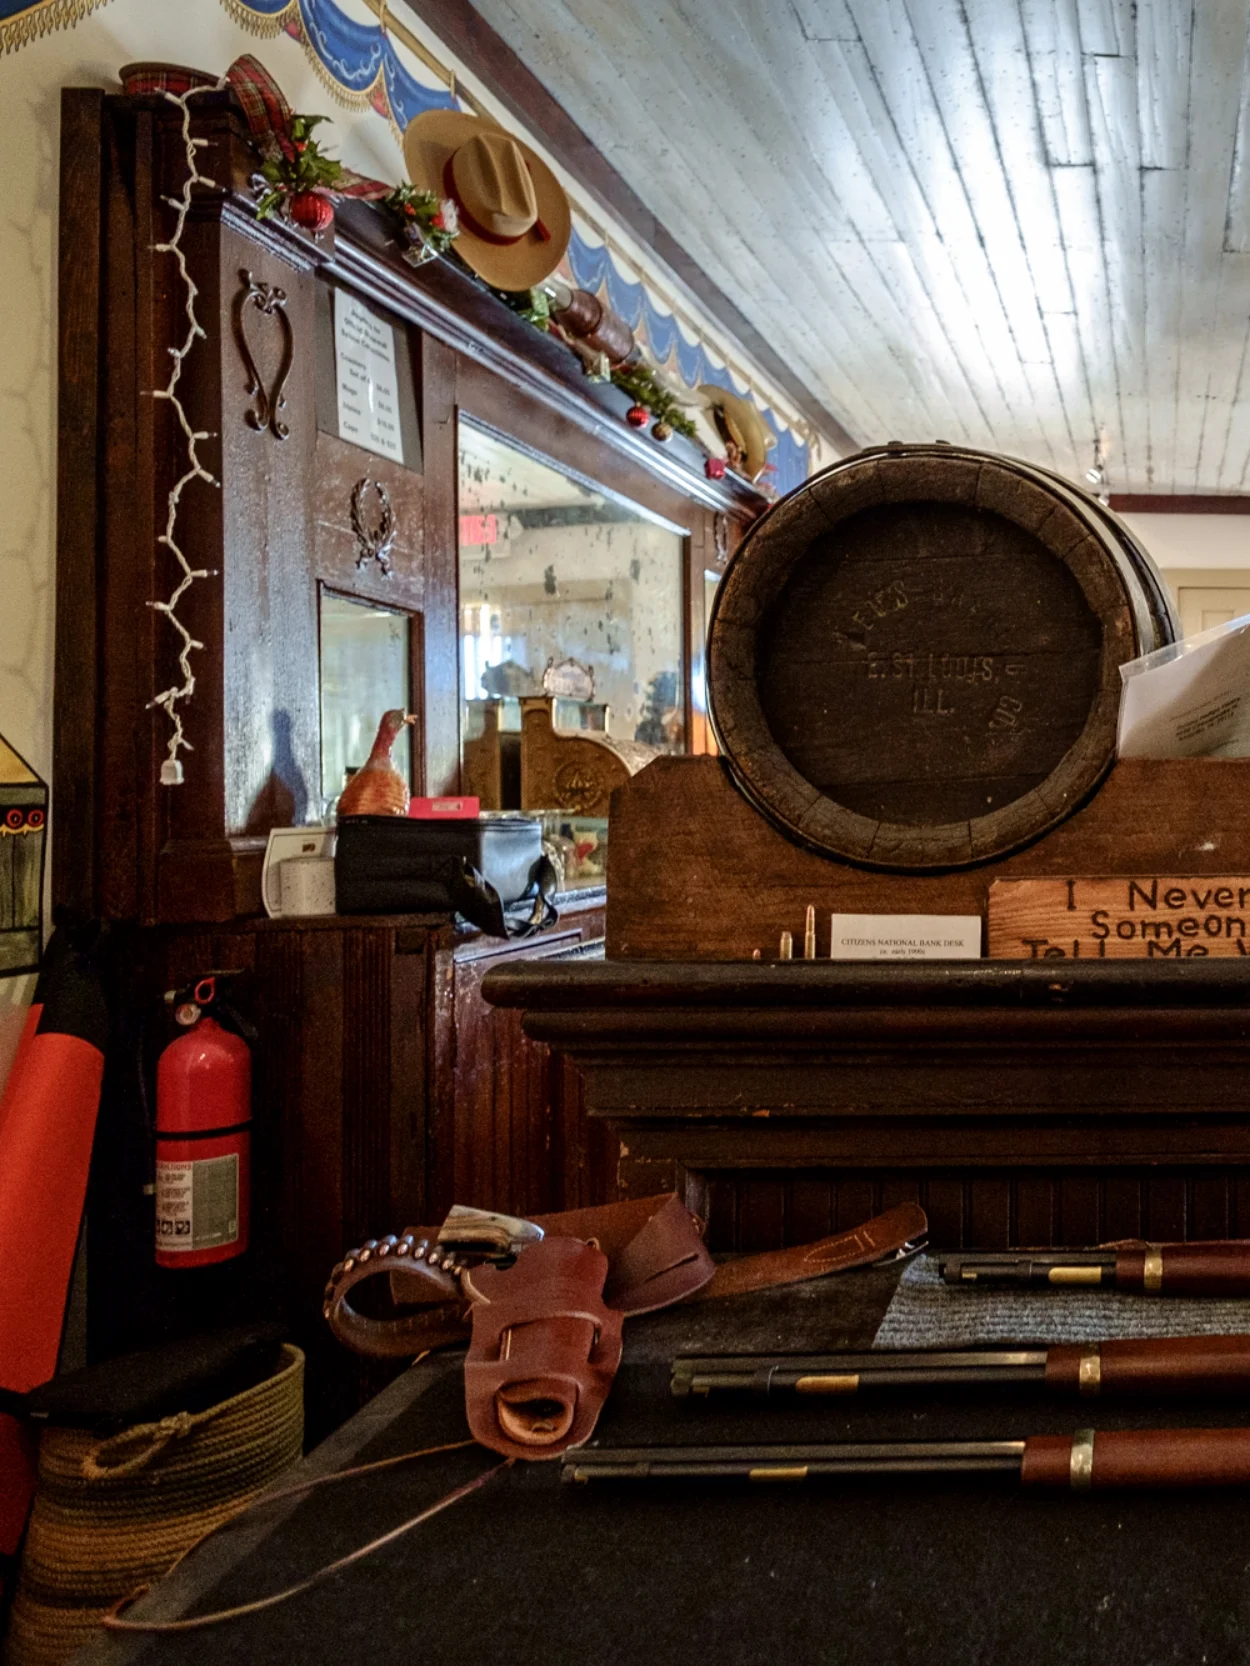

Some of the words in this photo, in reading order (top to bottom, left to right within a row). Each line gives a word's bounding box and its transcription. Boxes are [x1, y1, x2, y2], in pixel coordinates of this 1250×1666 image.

[1066, 879, 1077, 911] I
[840, 938, 876, 946] CITIZENS
[919, 939, 941, 947] BANK
[943, 939, 964, 947] DESK
